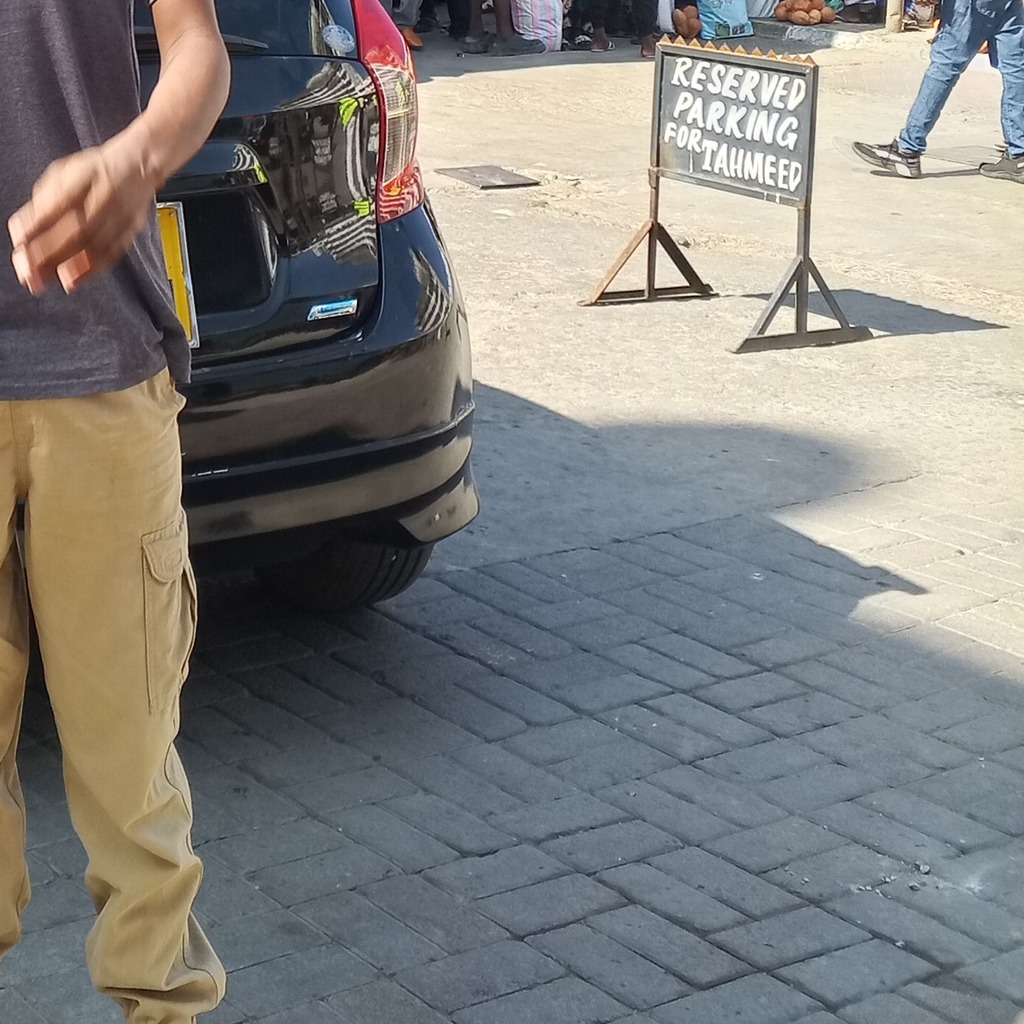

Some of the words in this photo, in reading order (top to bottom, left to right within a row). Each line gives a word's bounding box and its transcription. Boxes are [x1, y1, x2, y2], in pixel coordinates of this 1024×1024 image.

[670, 57, 806, 111] RESERVED
[673, 91, 799, 151] PARKING
[664, 122, 703, 154] FOR
[701, 139, 802, 193] TAHMEED
